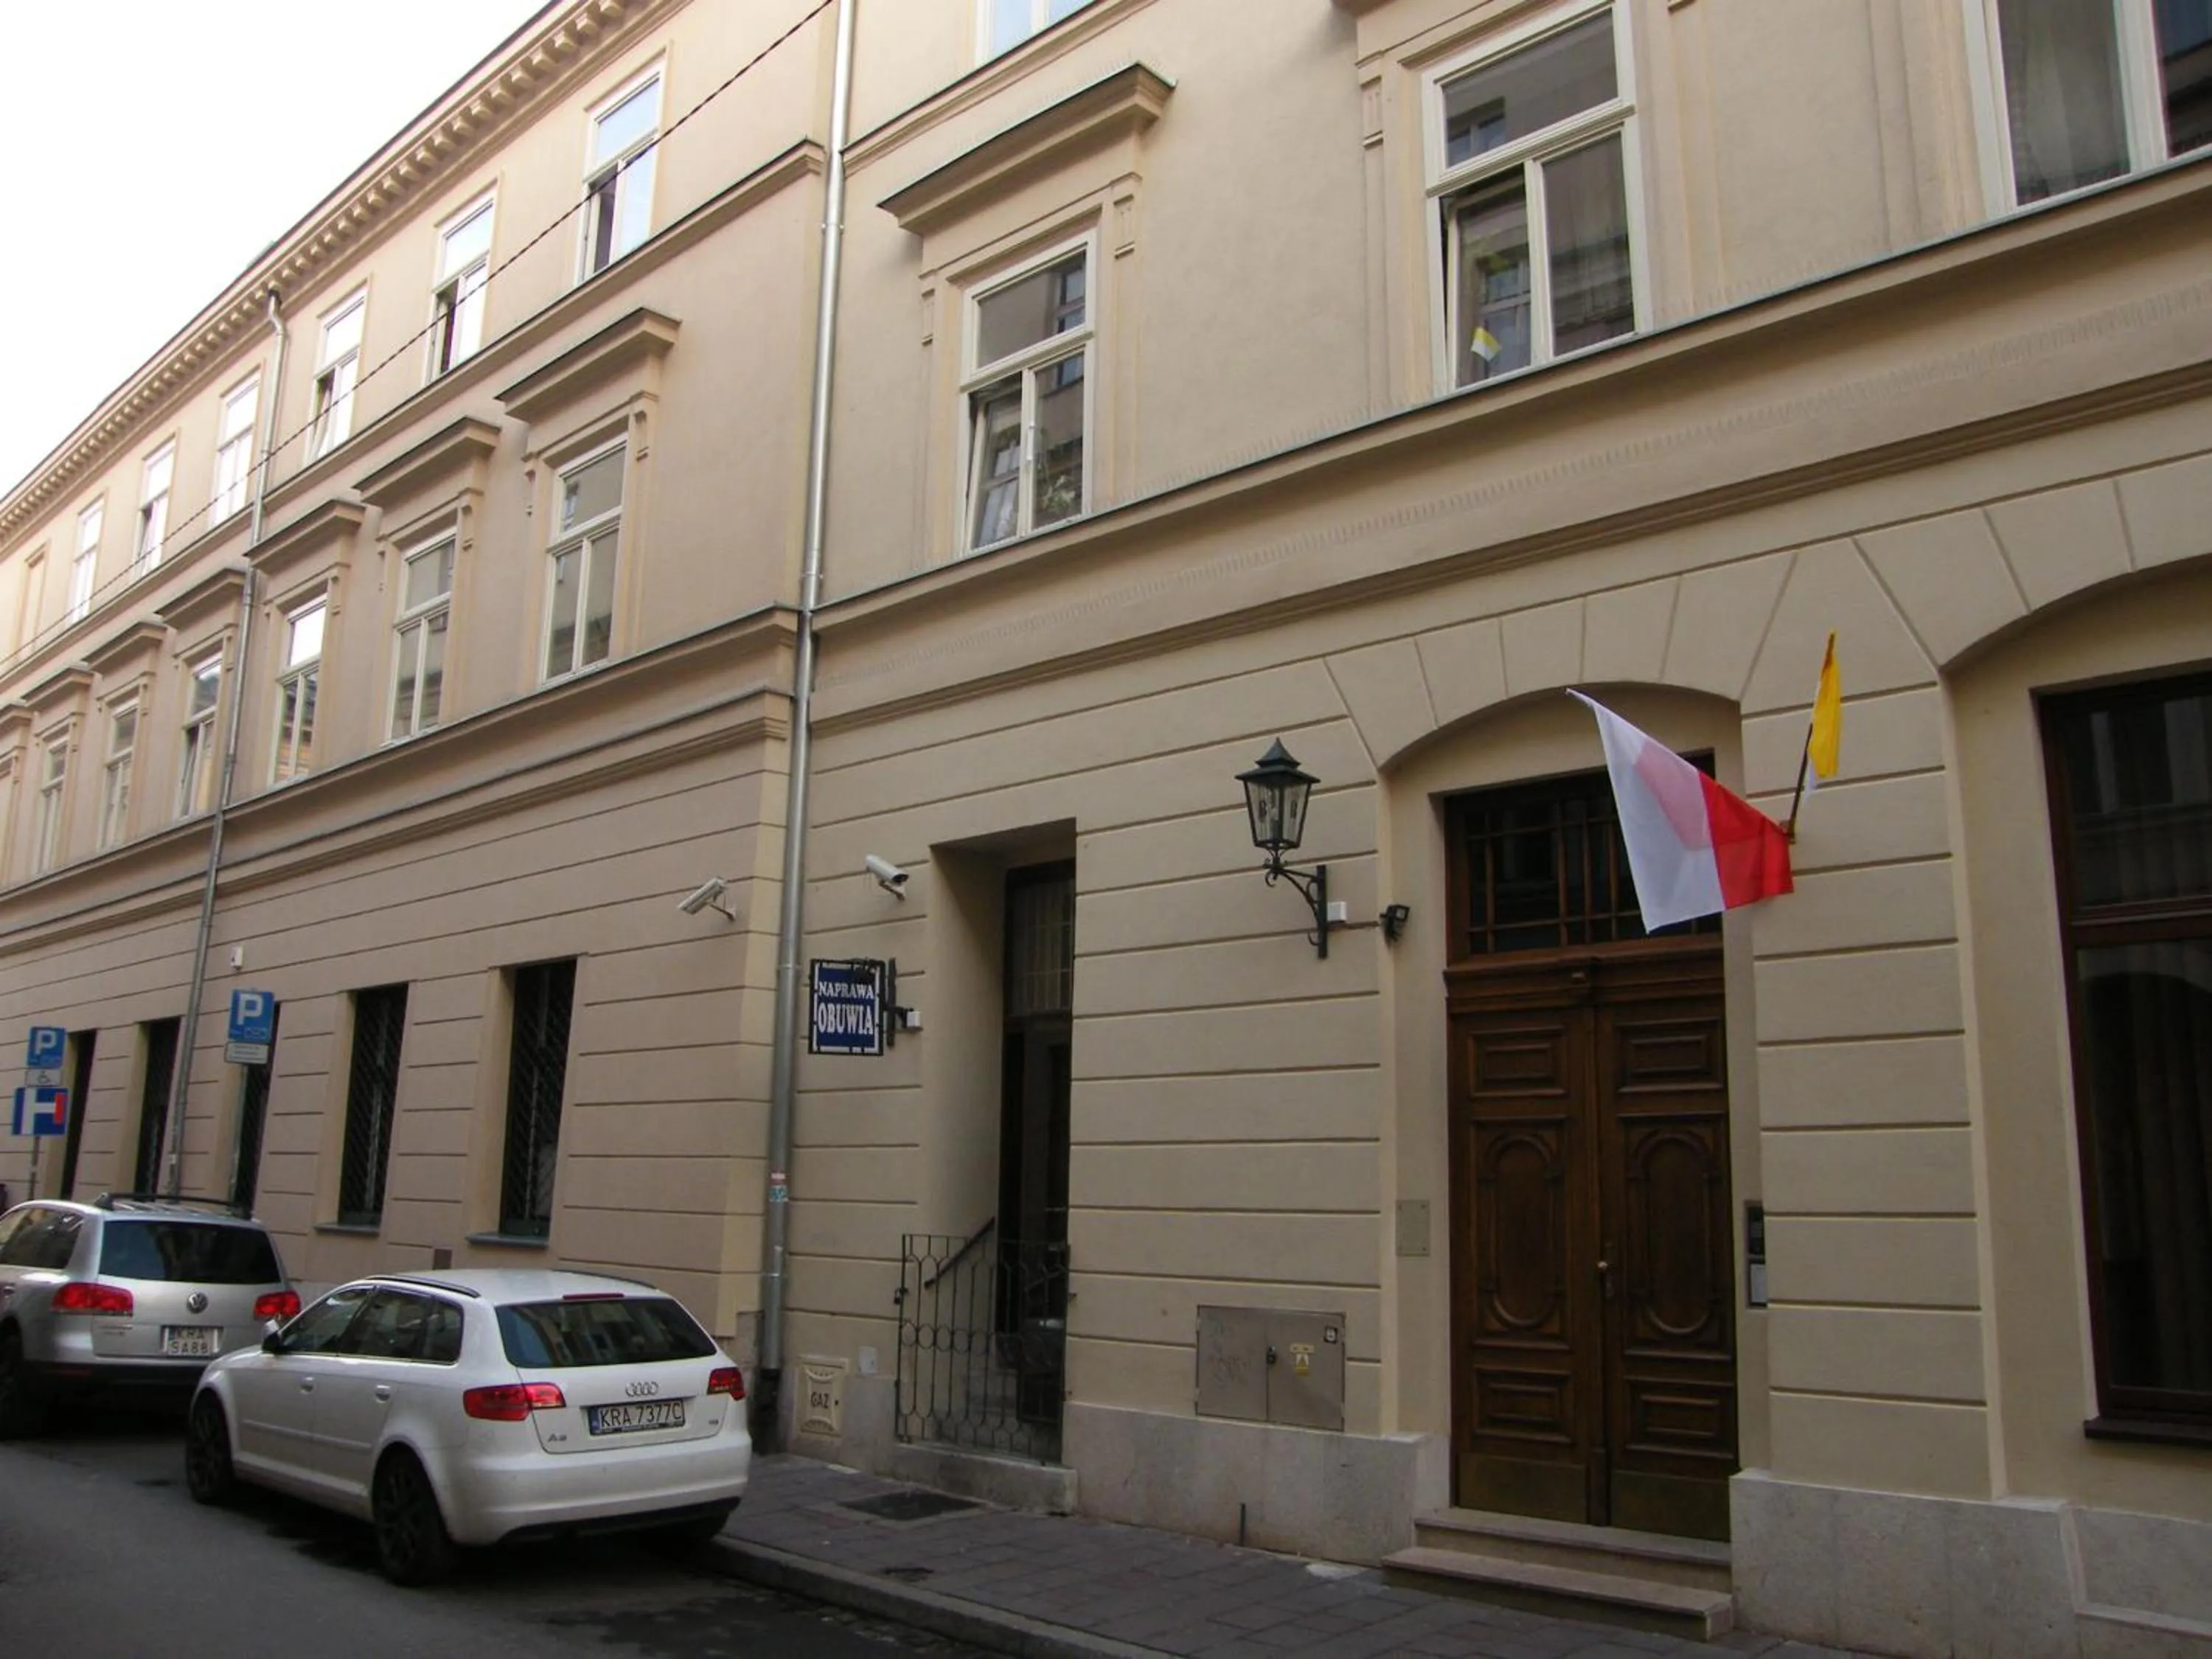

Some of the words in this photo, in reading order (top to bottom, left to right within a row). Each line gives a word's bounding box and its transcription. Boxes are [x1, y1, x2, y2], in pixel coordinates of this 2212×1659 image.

[818, 981, 874, 999] NAPRAWA
[237, 993, 263, 1025] P
[818, 1002, 874, 1034] OBUWIA
[35, 1031, 56, 1054] P
[811, 1391, 830, 1408] GAZ
[599, 1407, 631, 1427] KRA
[636, 1402, 682, 1424] 7377C
